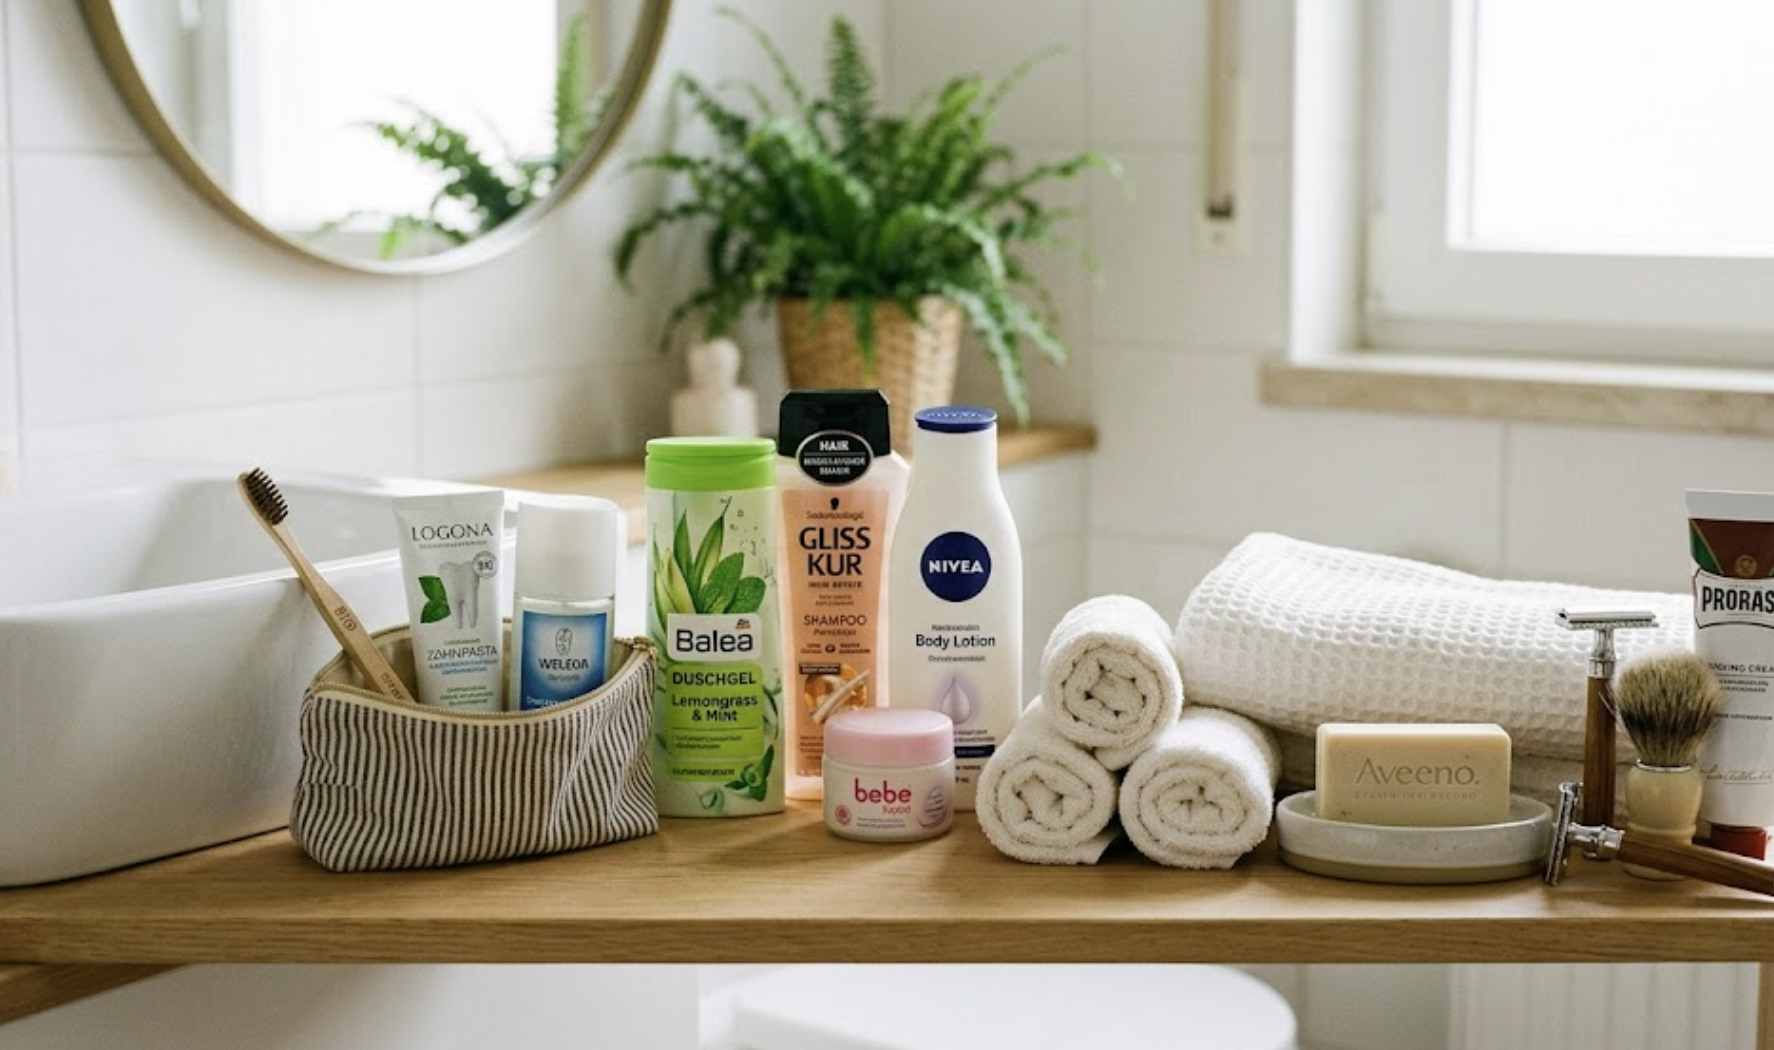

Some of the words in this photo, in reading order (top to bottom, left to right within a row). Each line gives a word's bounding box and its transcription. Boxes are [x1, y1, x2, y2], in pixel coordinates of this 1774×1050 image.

[819, 440, 849, 451] HAIR
[412, 522, 494, 541] LOGONA
[799, 526, 871, 550] GLISS
[808, 553, 862, 576] KUR
[928, 560, 984, 573] NIVEA
[1702, 586, 1774, 613] PRORAS
[804, 614, 868, 626] SHAMPOO
[676, 629, 754, 652] Balea
[915, 634, 950, 650] Body
[953, 635, 996, 647] Lotion
[672, 672, 757, 686] DUSCHGEL
[671, 693, 758, 709] Lemongrass
[692, 709, 702, 722] &
[854, 778, 912, 804] bebe
